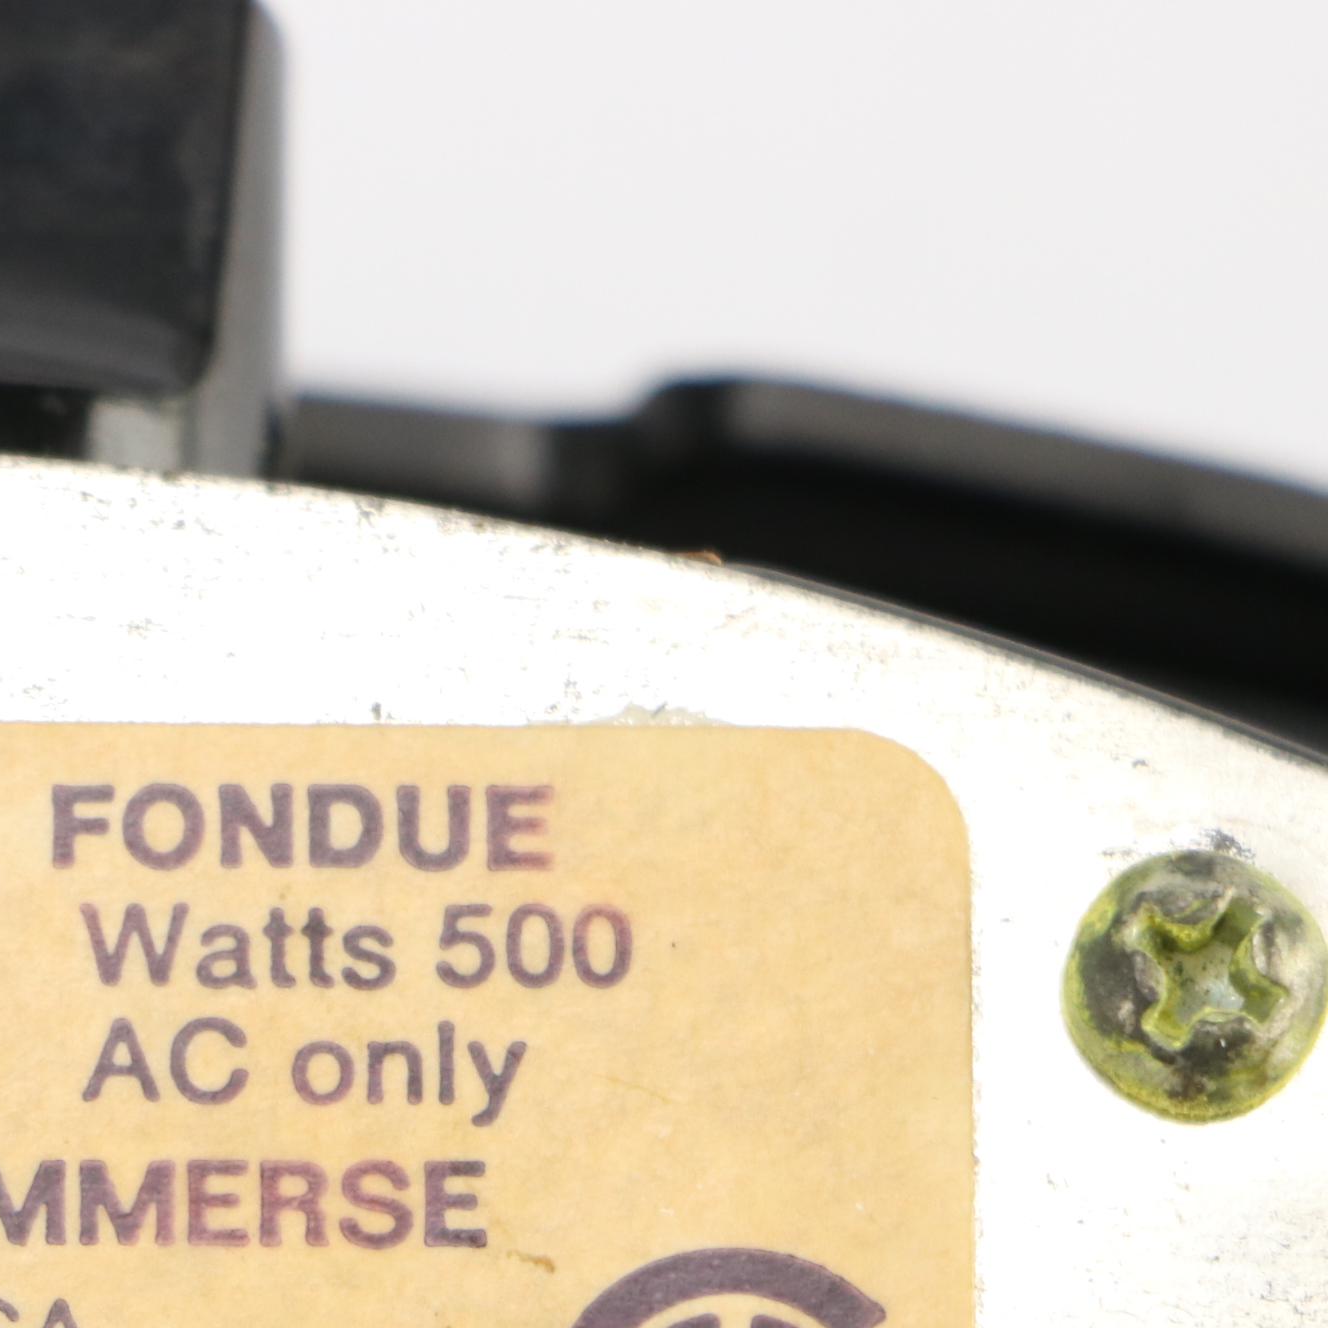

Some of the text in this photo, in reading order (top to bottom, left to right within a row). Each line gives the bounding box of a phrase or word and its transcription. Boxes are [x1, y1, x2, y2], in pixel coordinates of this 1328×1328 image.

[53, 785, 553, 870] FONDUE
[83, 905, 630, 990] Watts 500
[83, 1018, 526, 1126] AC only
